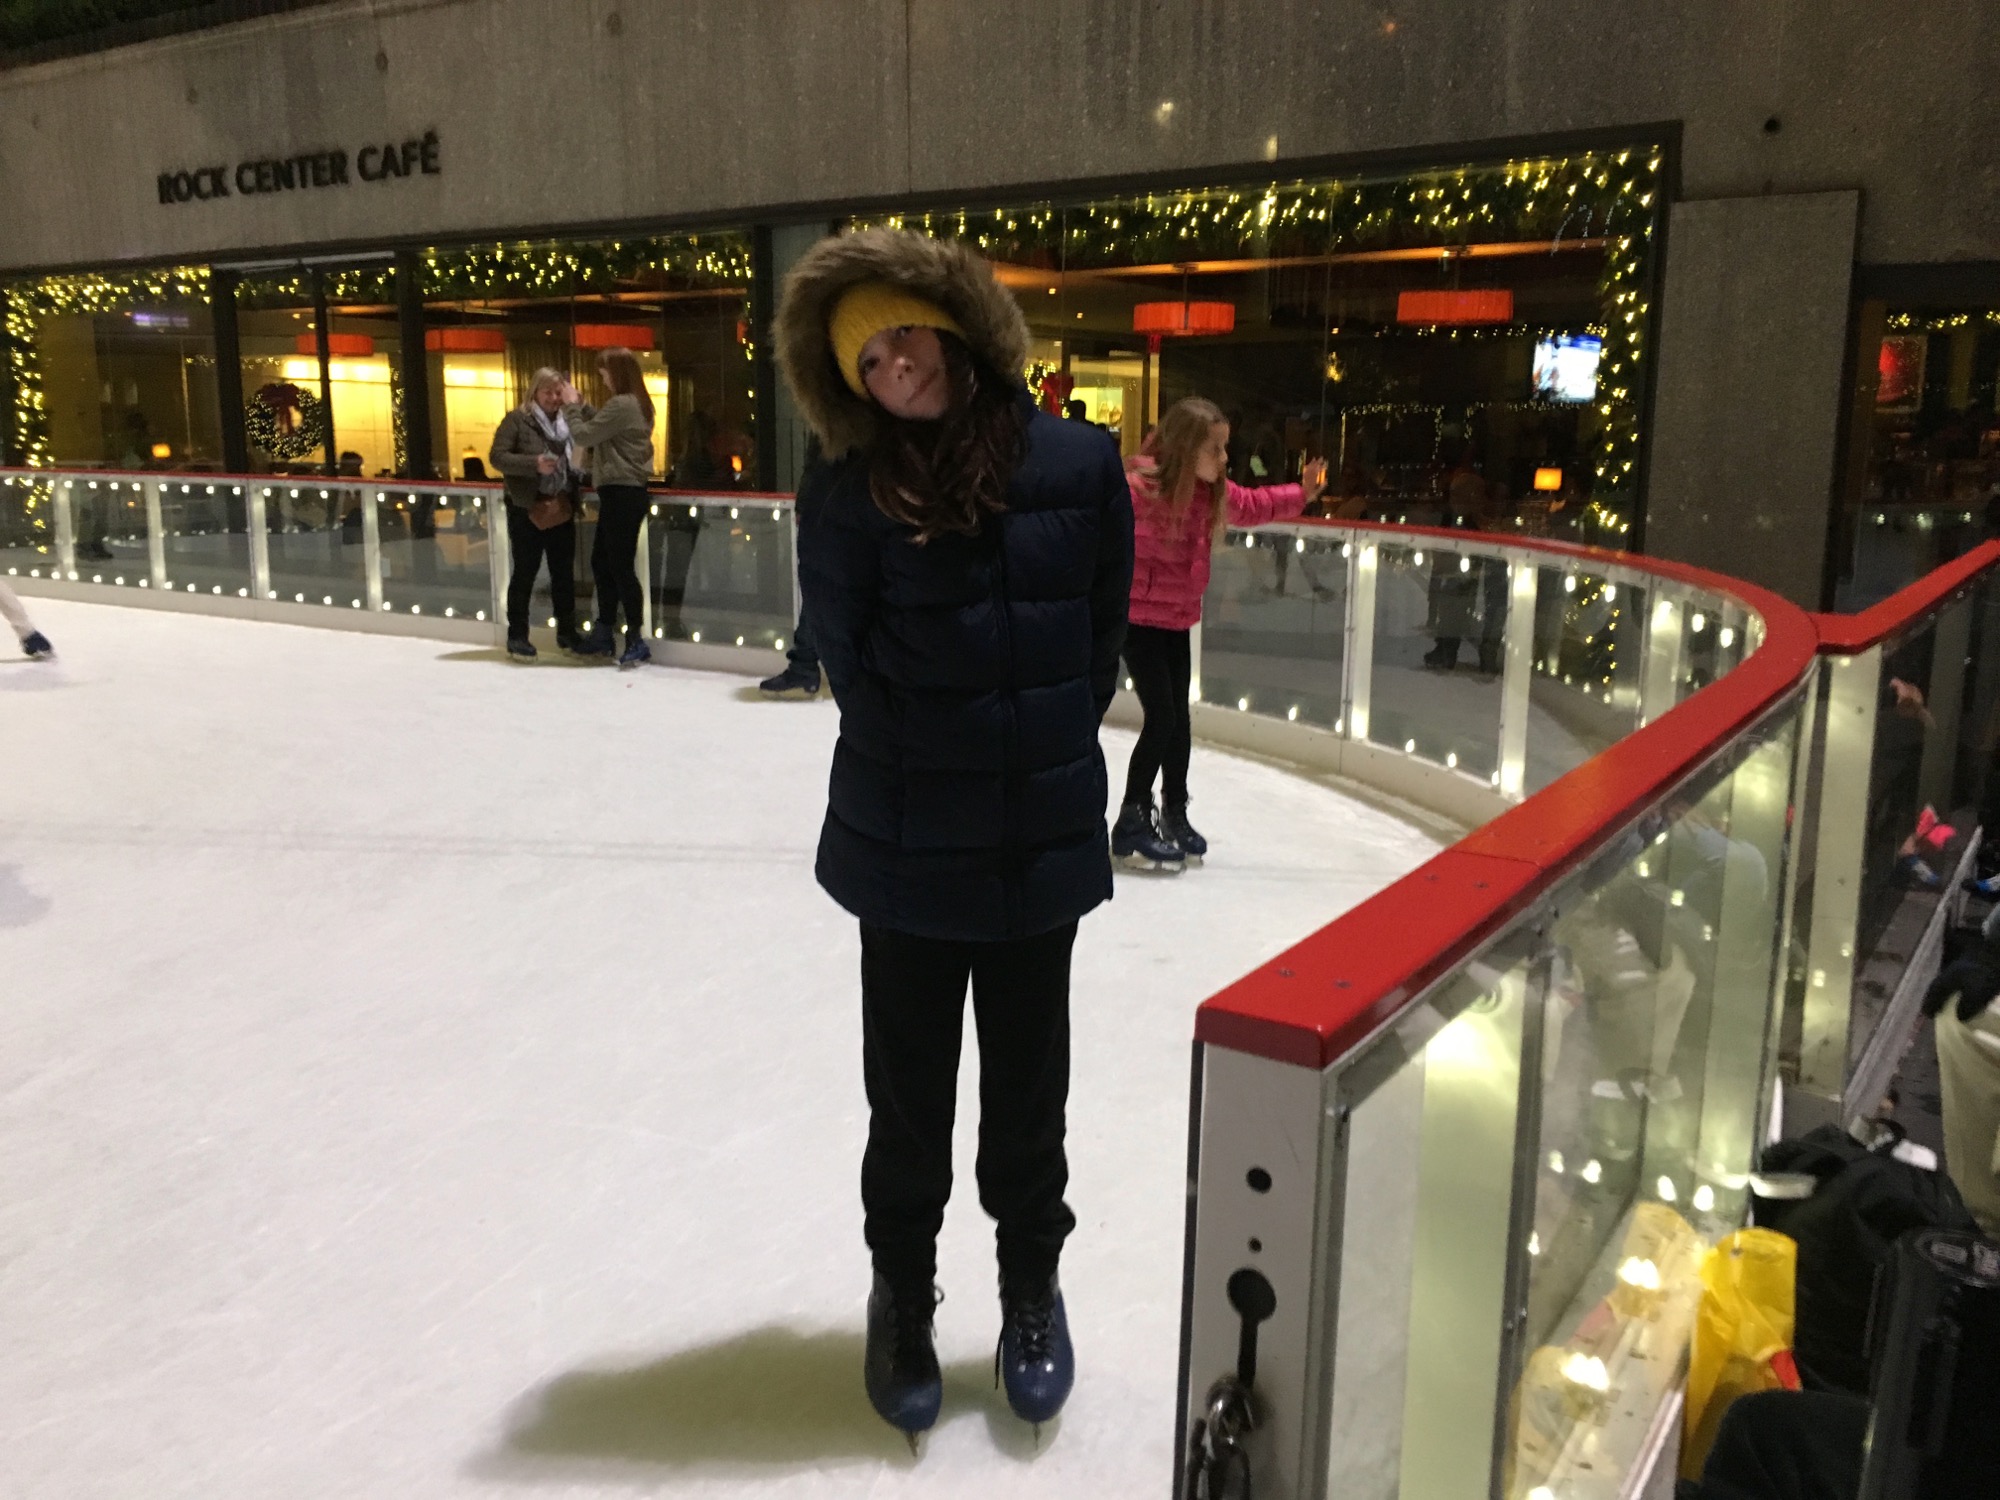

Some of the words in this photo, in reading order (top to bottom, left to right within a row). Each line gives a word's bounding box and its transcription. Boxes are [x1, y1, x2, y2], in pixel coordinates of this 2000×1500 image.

[157, 165, 230, 204] ROCK
[235, 150, 349, 195] CENTER
[357, 129, 441, 181] CAFÉ
